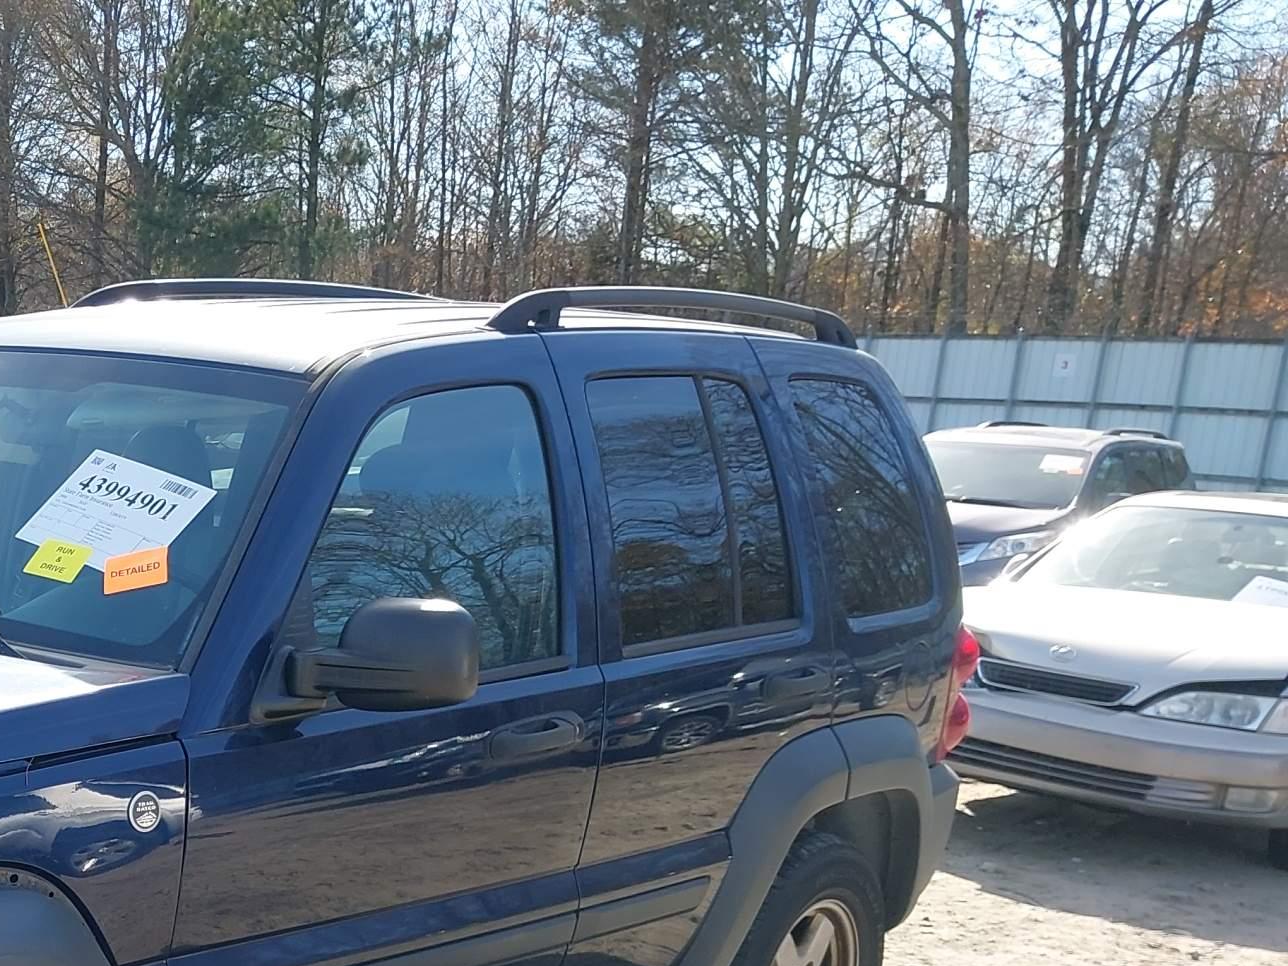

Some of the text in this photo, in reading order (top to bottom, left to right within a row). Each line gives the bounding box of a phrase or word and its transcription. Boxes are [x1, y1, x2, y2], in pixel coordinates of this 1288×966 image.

[79, 474, 179, 521] 43994901
[56, 546, 75, 556] RUN
[40, 562, 66, 574] DRIVE
[110, 561, 161, 579] DETAILED
